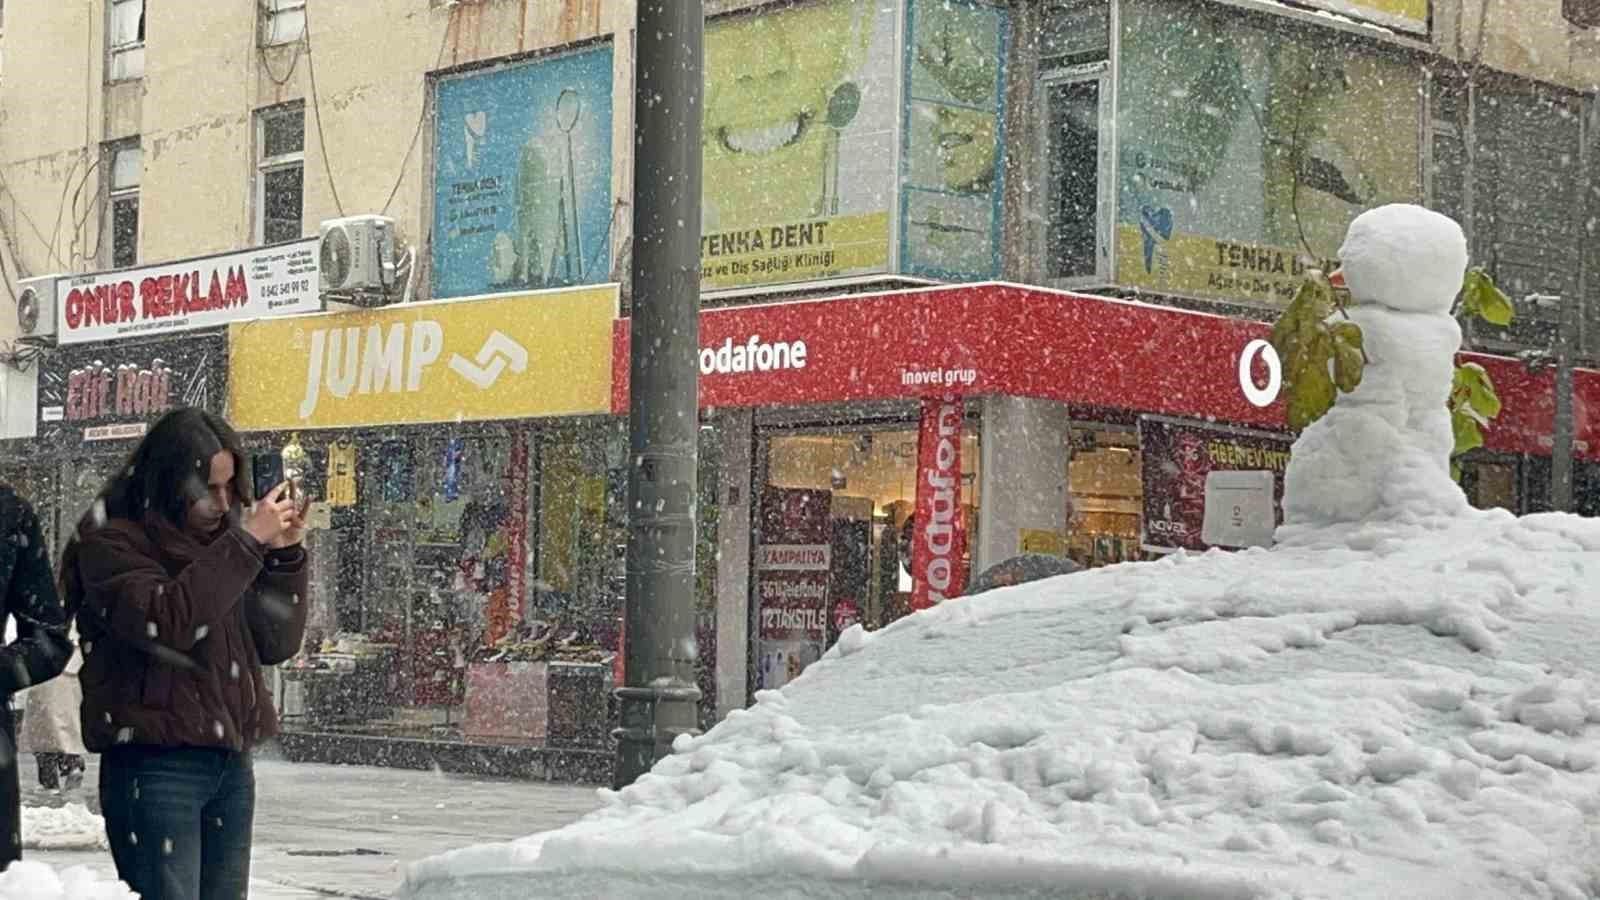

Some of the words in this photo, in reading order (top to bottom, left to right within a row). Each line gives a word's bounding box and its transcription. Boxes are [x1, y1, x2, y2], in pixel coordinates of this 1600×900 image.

[770, 221, 828, 249] DENT
[715, 265, 729, 276] ve
[731, 261, 750, 275] Diş
[795, 250, 835, 267] Kliniği
[1215, 241, 1285, 273] TENHA
[65, 280, 137, 329] ONUR
[139, 264, 249, 319] REKLAM
[299, 319, 444, 420] JUMP
[697, 334, 807, 375] odafone
[901, 366, 943, 385] inovel
[944, 367, 977, 387] grup
[926, 394, 956, 604] odafon
